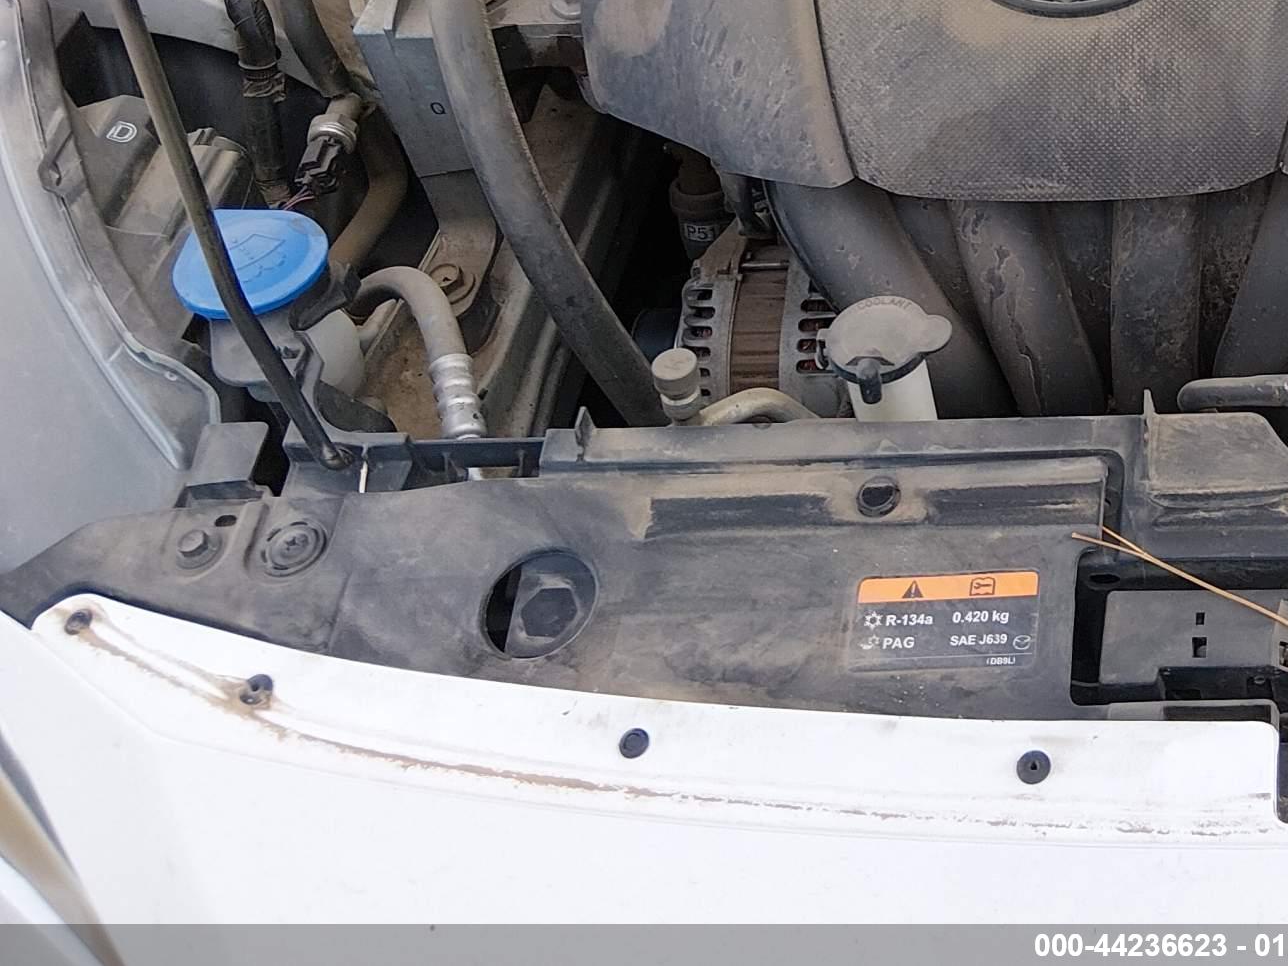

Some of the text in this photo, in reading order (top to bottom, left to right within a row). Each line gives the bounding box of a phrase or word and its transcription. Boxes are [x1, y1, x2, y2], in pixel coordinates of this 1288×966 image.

[857, 297, 912, 310] COOLANT
[885, 610, 1010, 626] R-134a 0.420 kg
[882, 634, 1008, 649] PAG SAE J639
